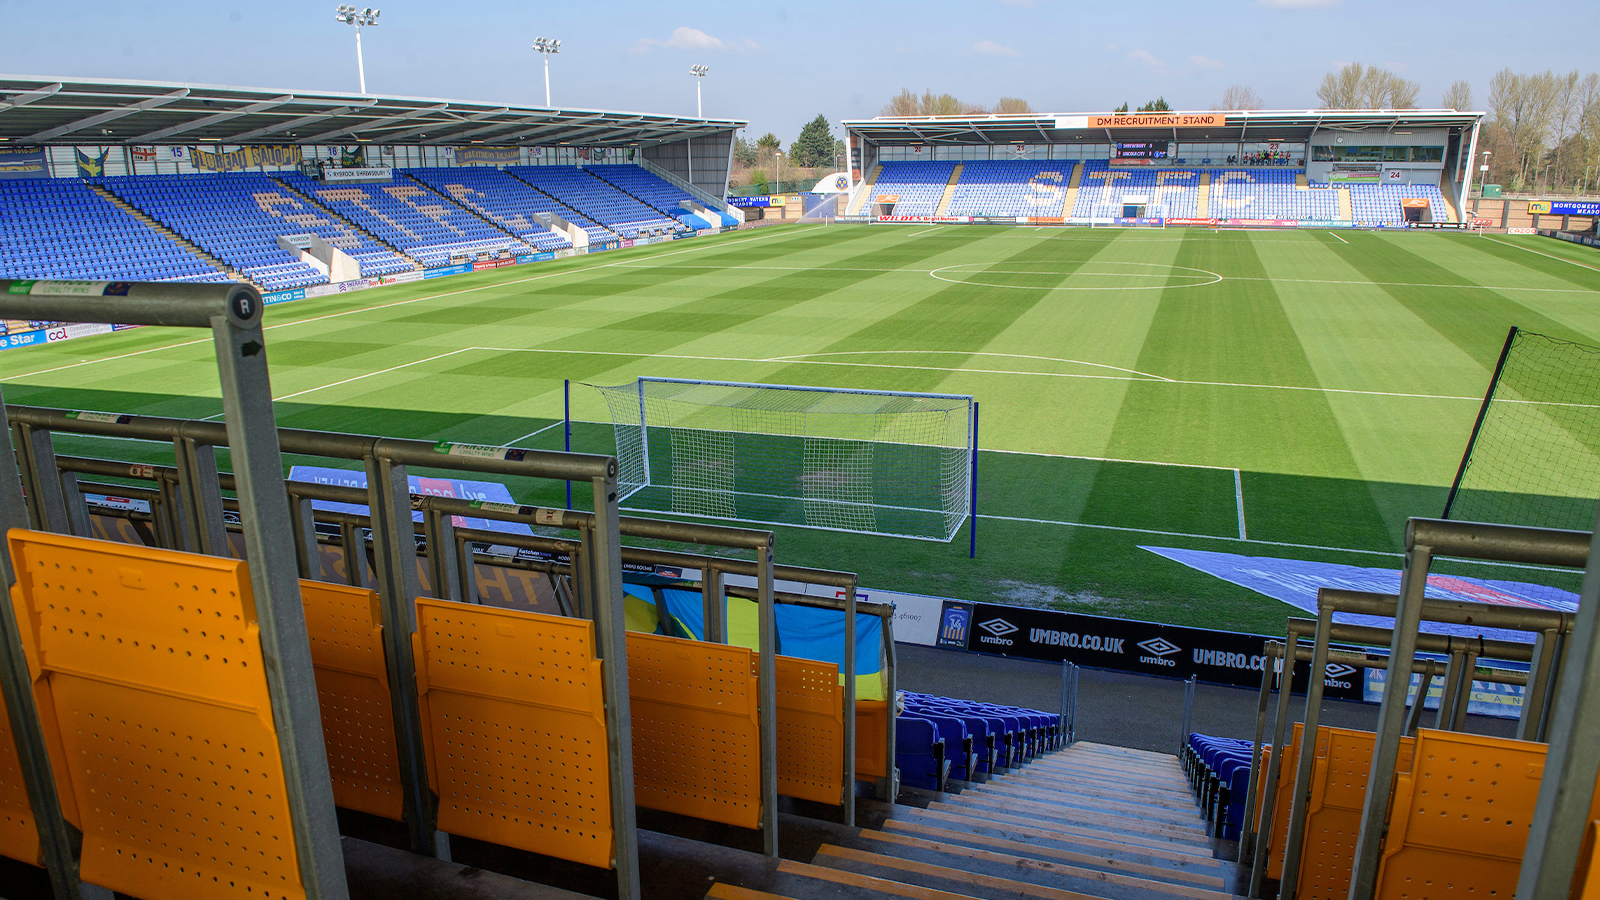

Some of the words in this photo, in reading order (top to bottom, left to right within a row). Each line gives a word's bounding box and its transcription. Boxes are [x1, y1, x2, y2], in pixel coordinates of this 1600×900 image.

[1097, 118, 1112, 126] DM
[1114, 117, 1181, 126] RECRUITMENT
[1183, 116, 1214, 125] STAND
[171, 147, 183, 157] 15
[445, 147, 453, 155] 17
[189, 149, 246, 170] FLOREAT
[346, 279, 369, 288] SHERRATT
[72, 286, 90, 294] WINS
[240, 299, 250, 314] R
[10, 333, 35, 345] Star
[49, 327, 68, 341] ccl
[899, 612, 921, 622] 461007
[980, 635, 1013, 646] umbro
[1029, 627, 1125, 654] UMBRO.CO.UK
[1139, 655, 1176, 667] umbro
[1323, 678, 1352, 689] mbro
